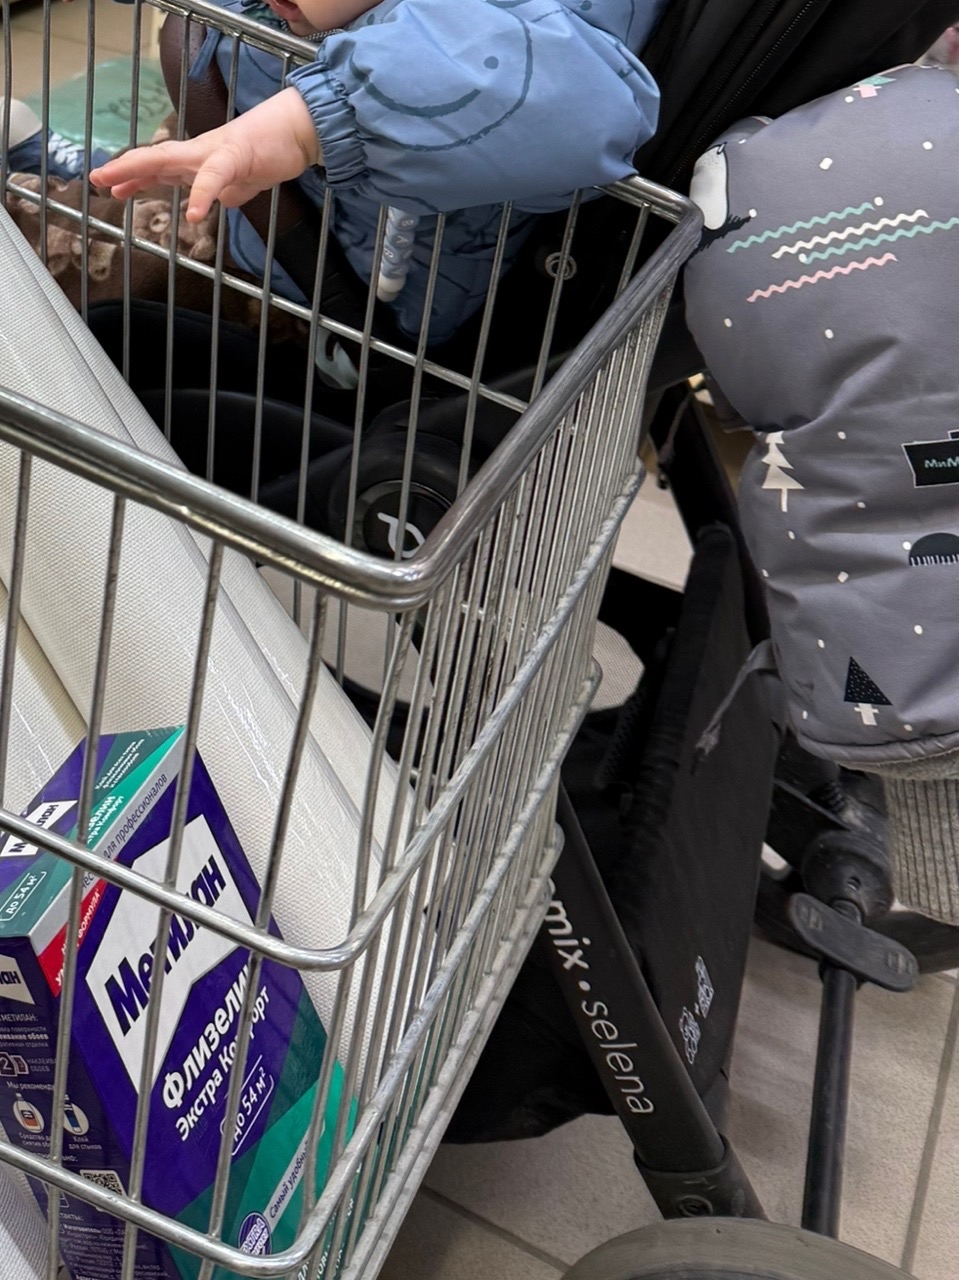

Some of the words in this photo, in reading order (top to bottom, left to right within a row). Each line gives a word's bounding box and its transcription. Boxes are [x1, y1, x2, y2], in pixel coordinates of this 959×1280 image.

[109, 772, 174, 846] профессионалов
[16, 885, 27, 904] 54
[2, 1057, 11, 1071] 2
[582, 1000, 654, 1114] selena
[175, 1068, 223, 1142] Экстра
[241, 1084, 258, 1116] 54
[269, 1182, 289, 1219] Самый
